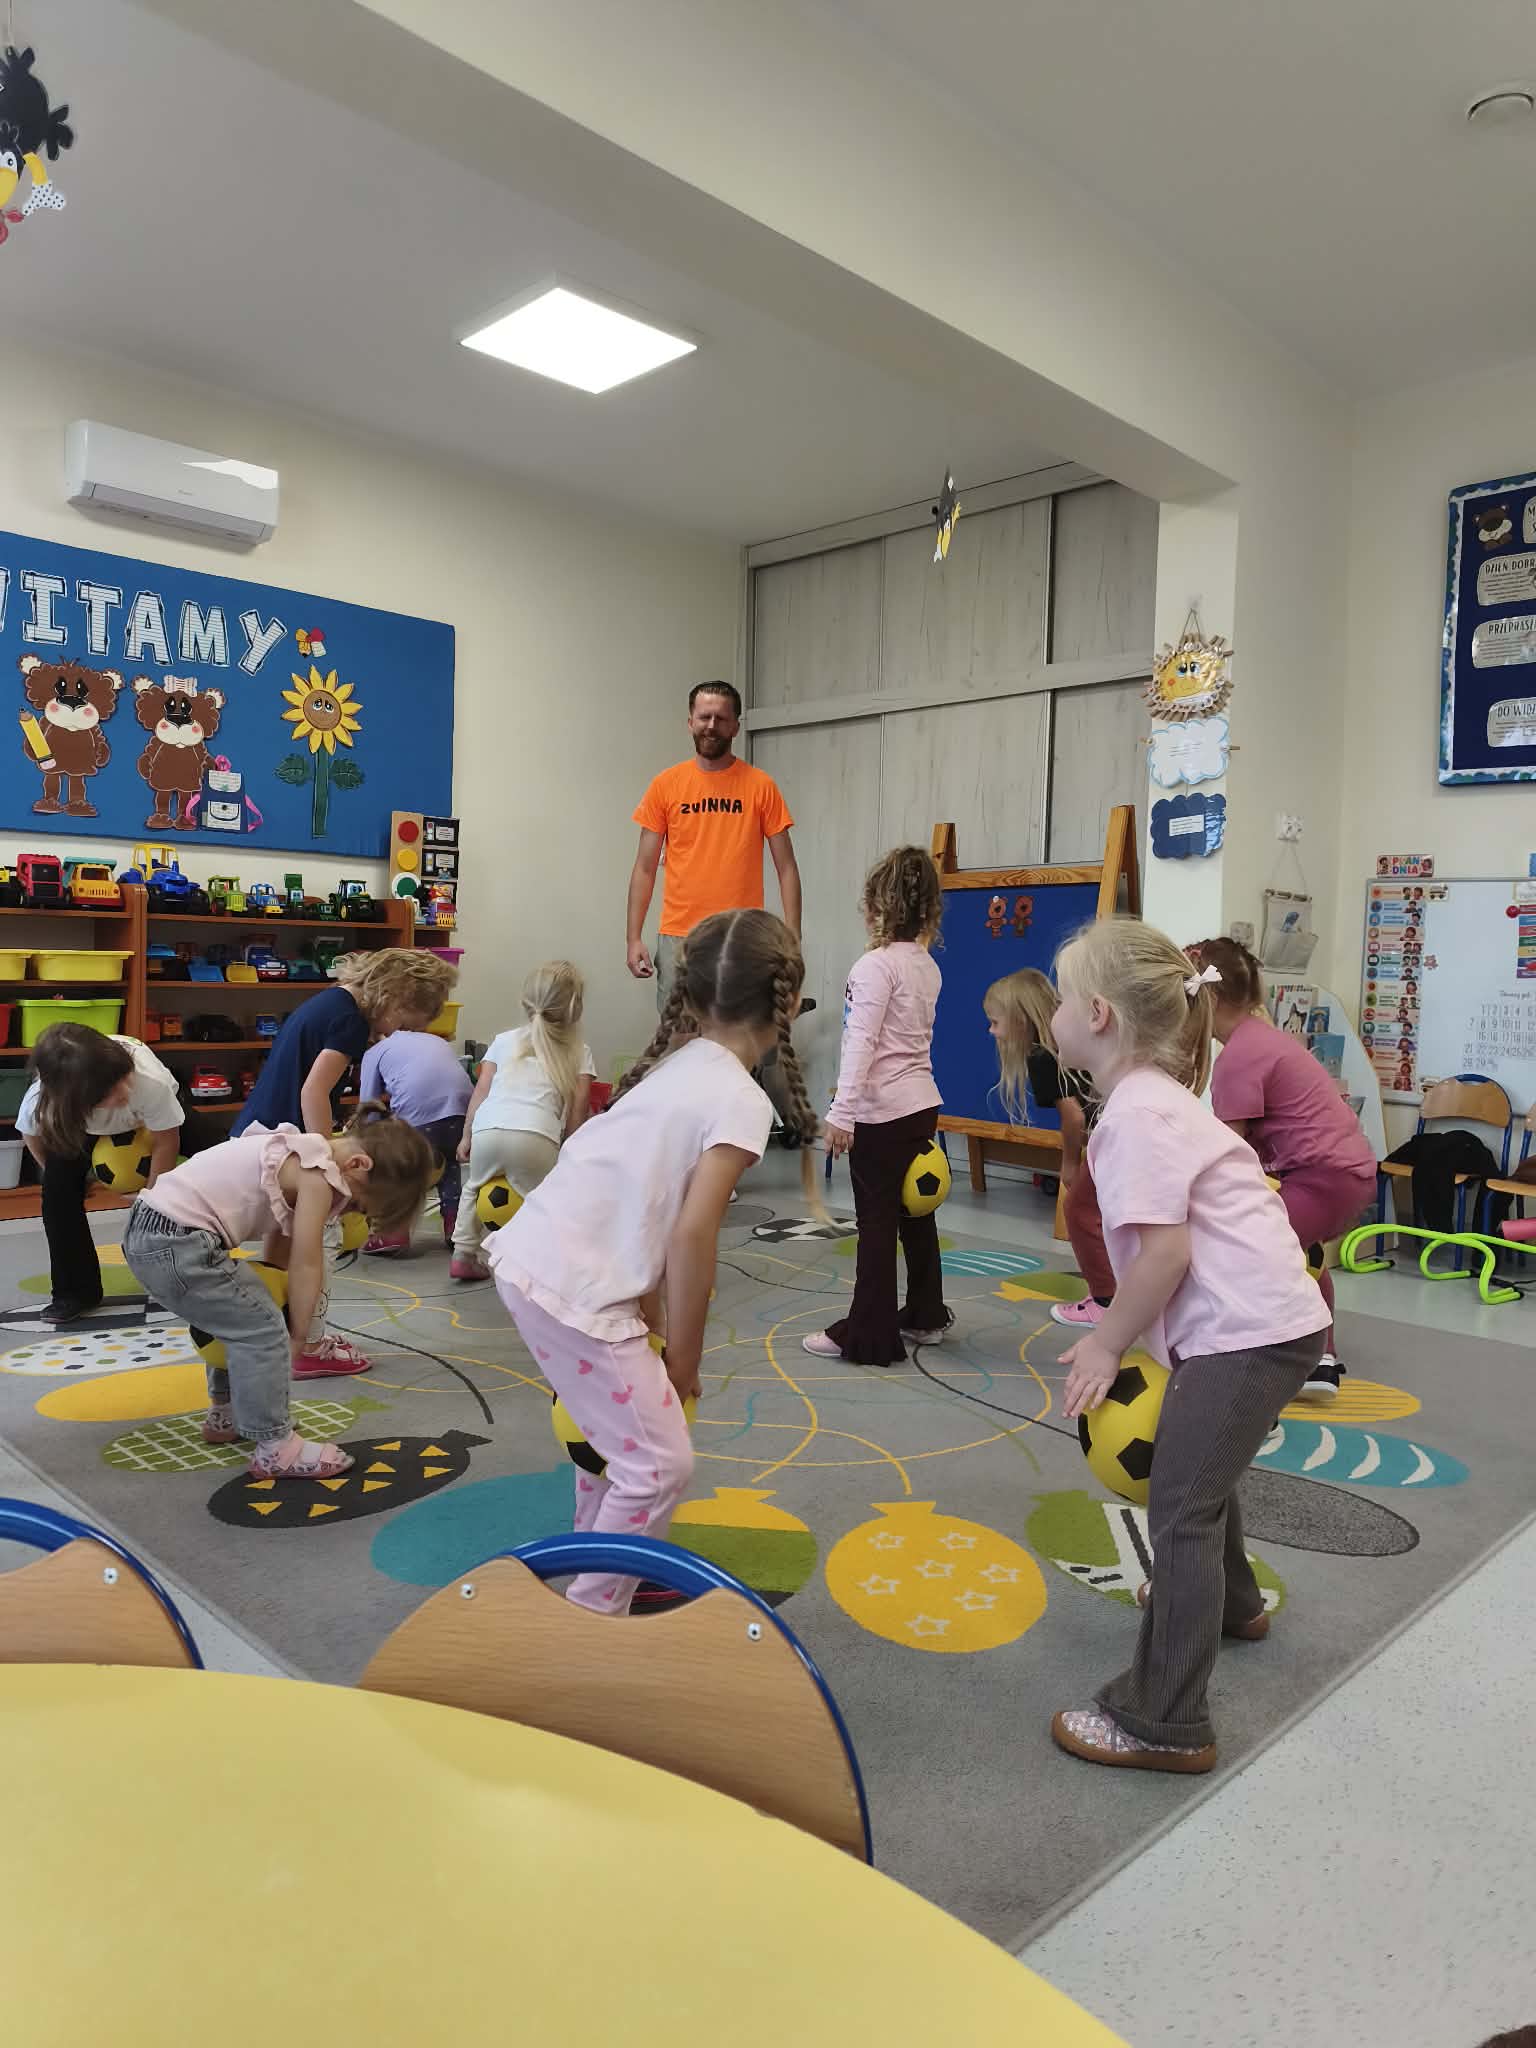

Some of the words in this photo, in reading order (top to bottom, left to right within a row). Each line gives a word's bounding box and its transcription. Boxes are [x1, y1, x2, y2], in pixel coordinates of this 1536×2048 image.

[0, 566, 288, 676] ITAMY
[1488, 618, 1536, 635] PRZEPRASZ
[1392, 865, 1418, 874] DNIA
